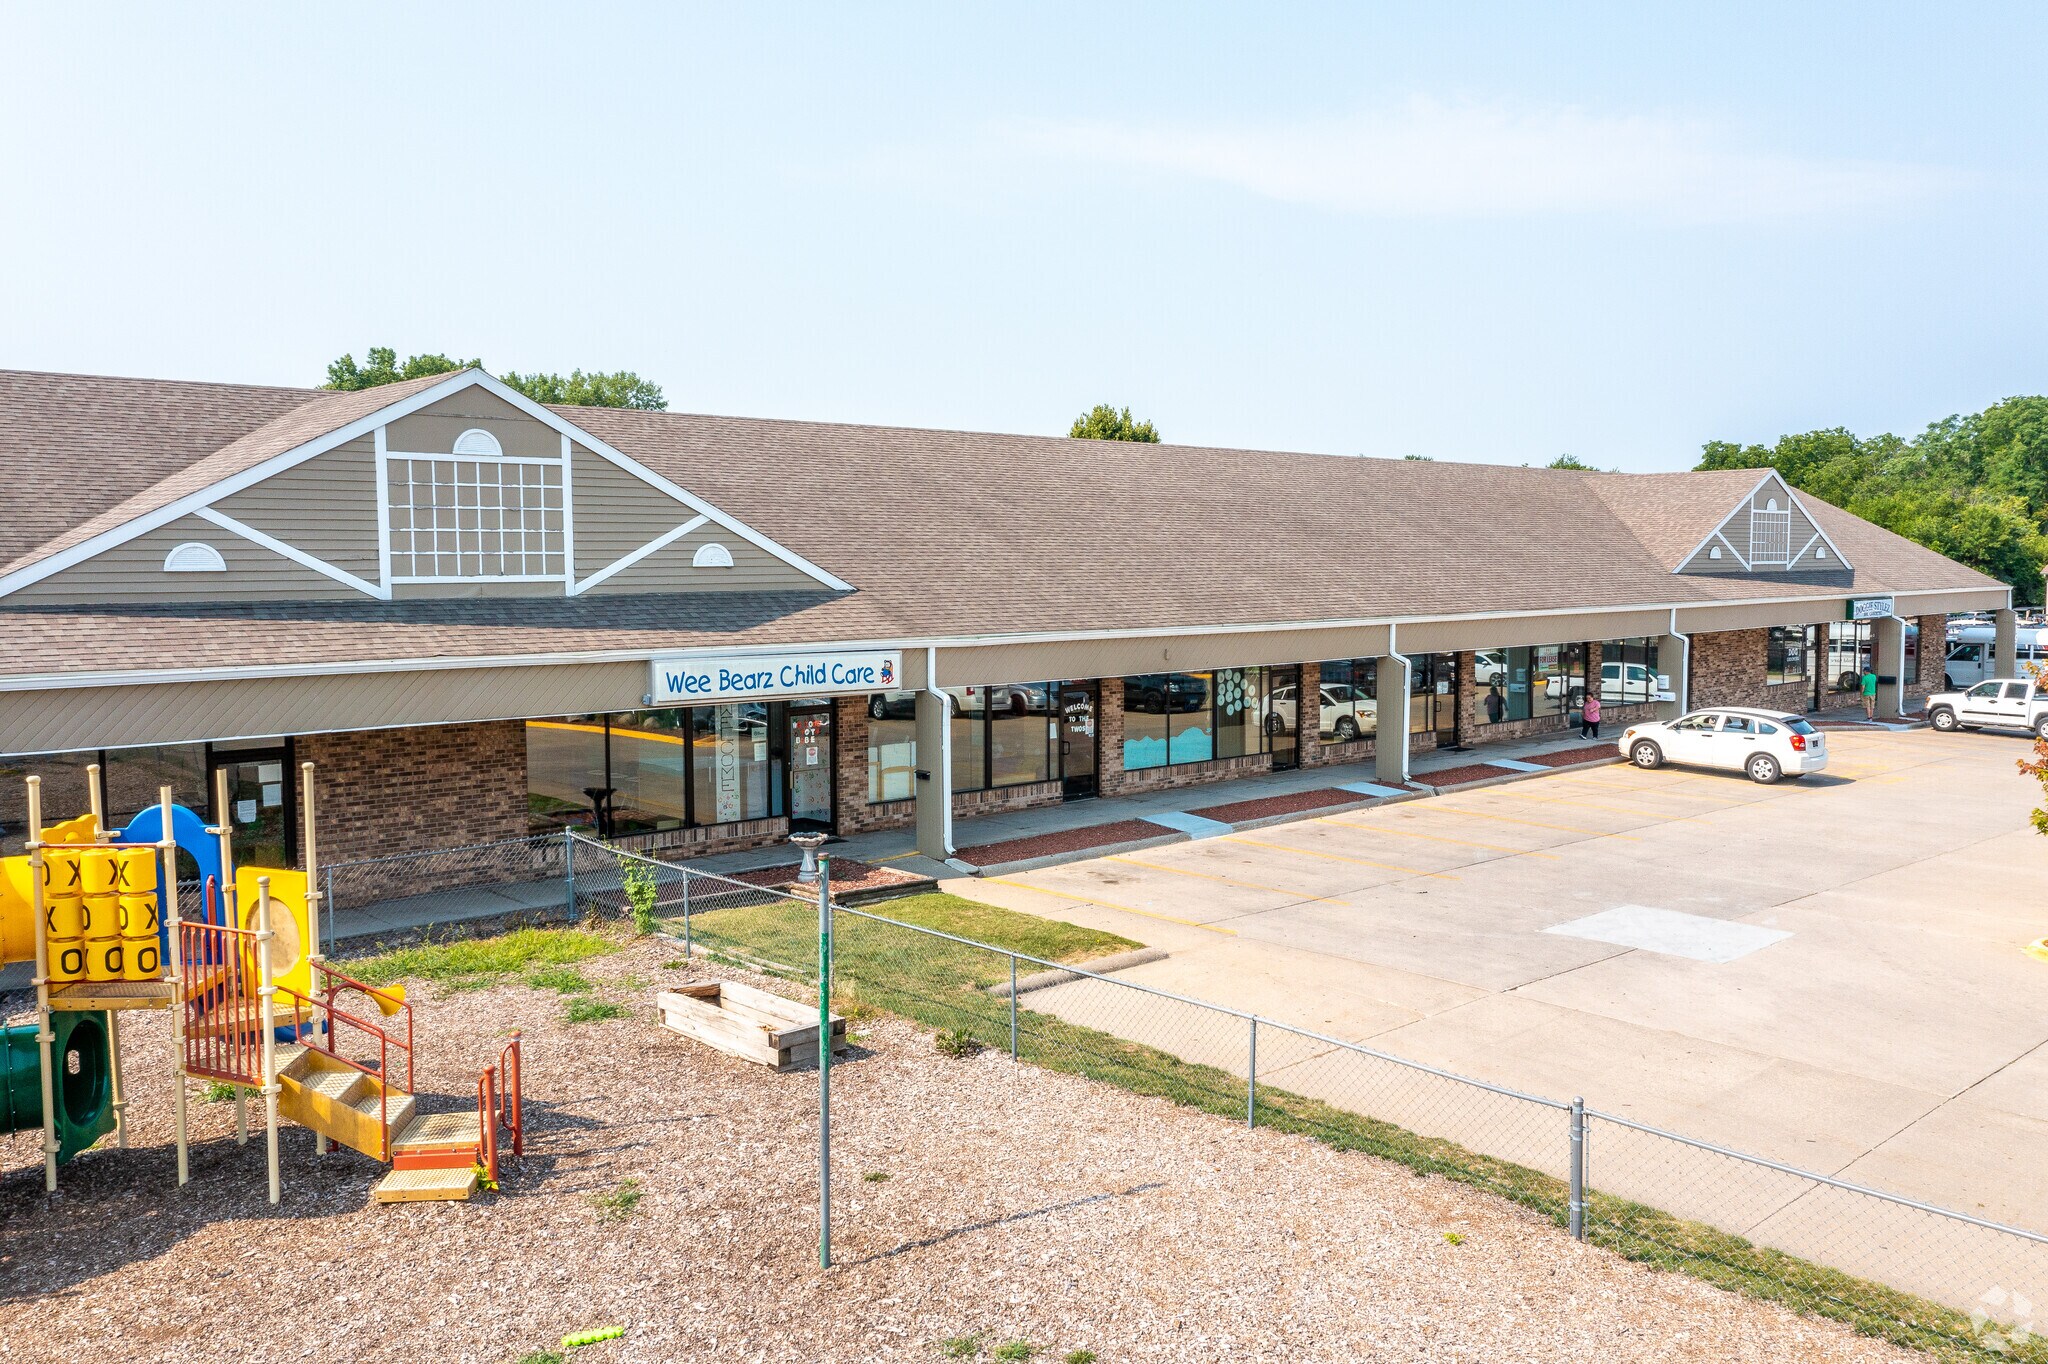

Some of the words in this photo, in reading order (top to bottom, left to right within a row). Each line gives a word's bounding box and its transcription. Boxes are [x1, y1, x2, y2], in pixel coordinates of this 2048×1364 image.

[666, 671, 712, 693] Wee
[719, 669, 774, 691] Bearz
[780, 662, 827, 687] Child
[832, 662, 875, 685] Care
[1065, 703, 1093, 713] WELCOME
